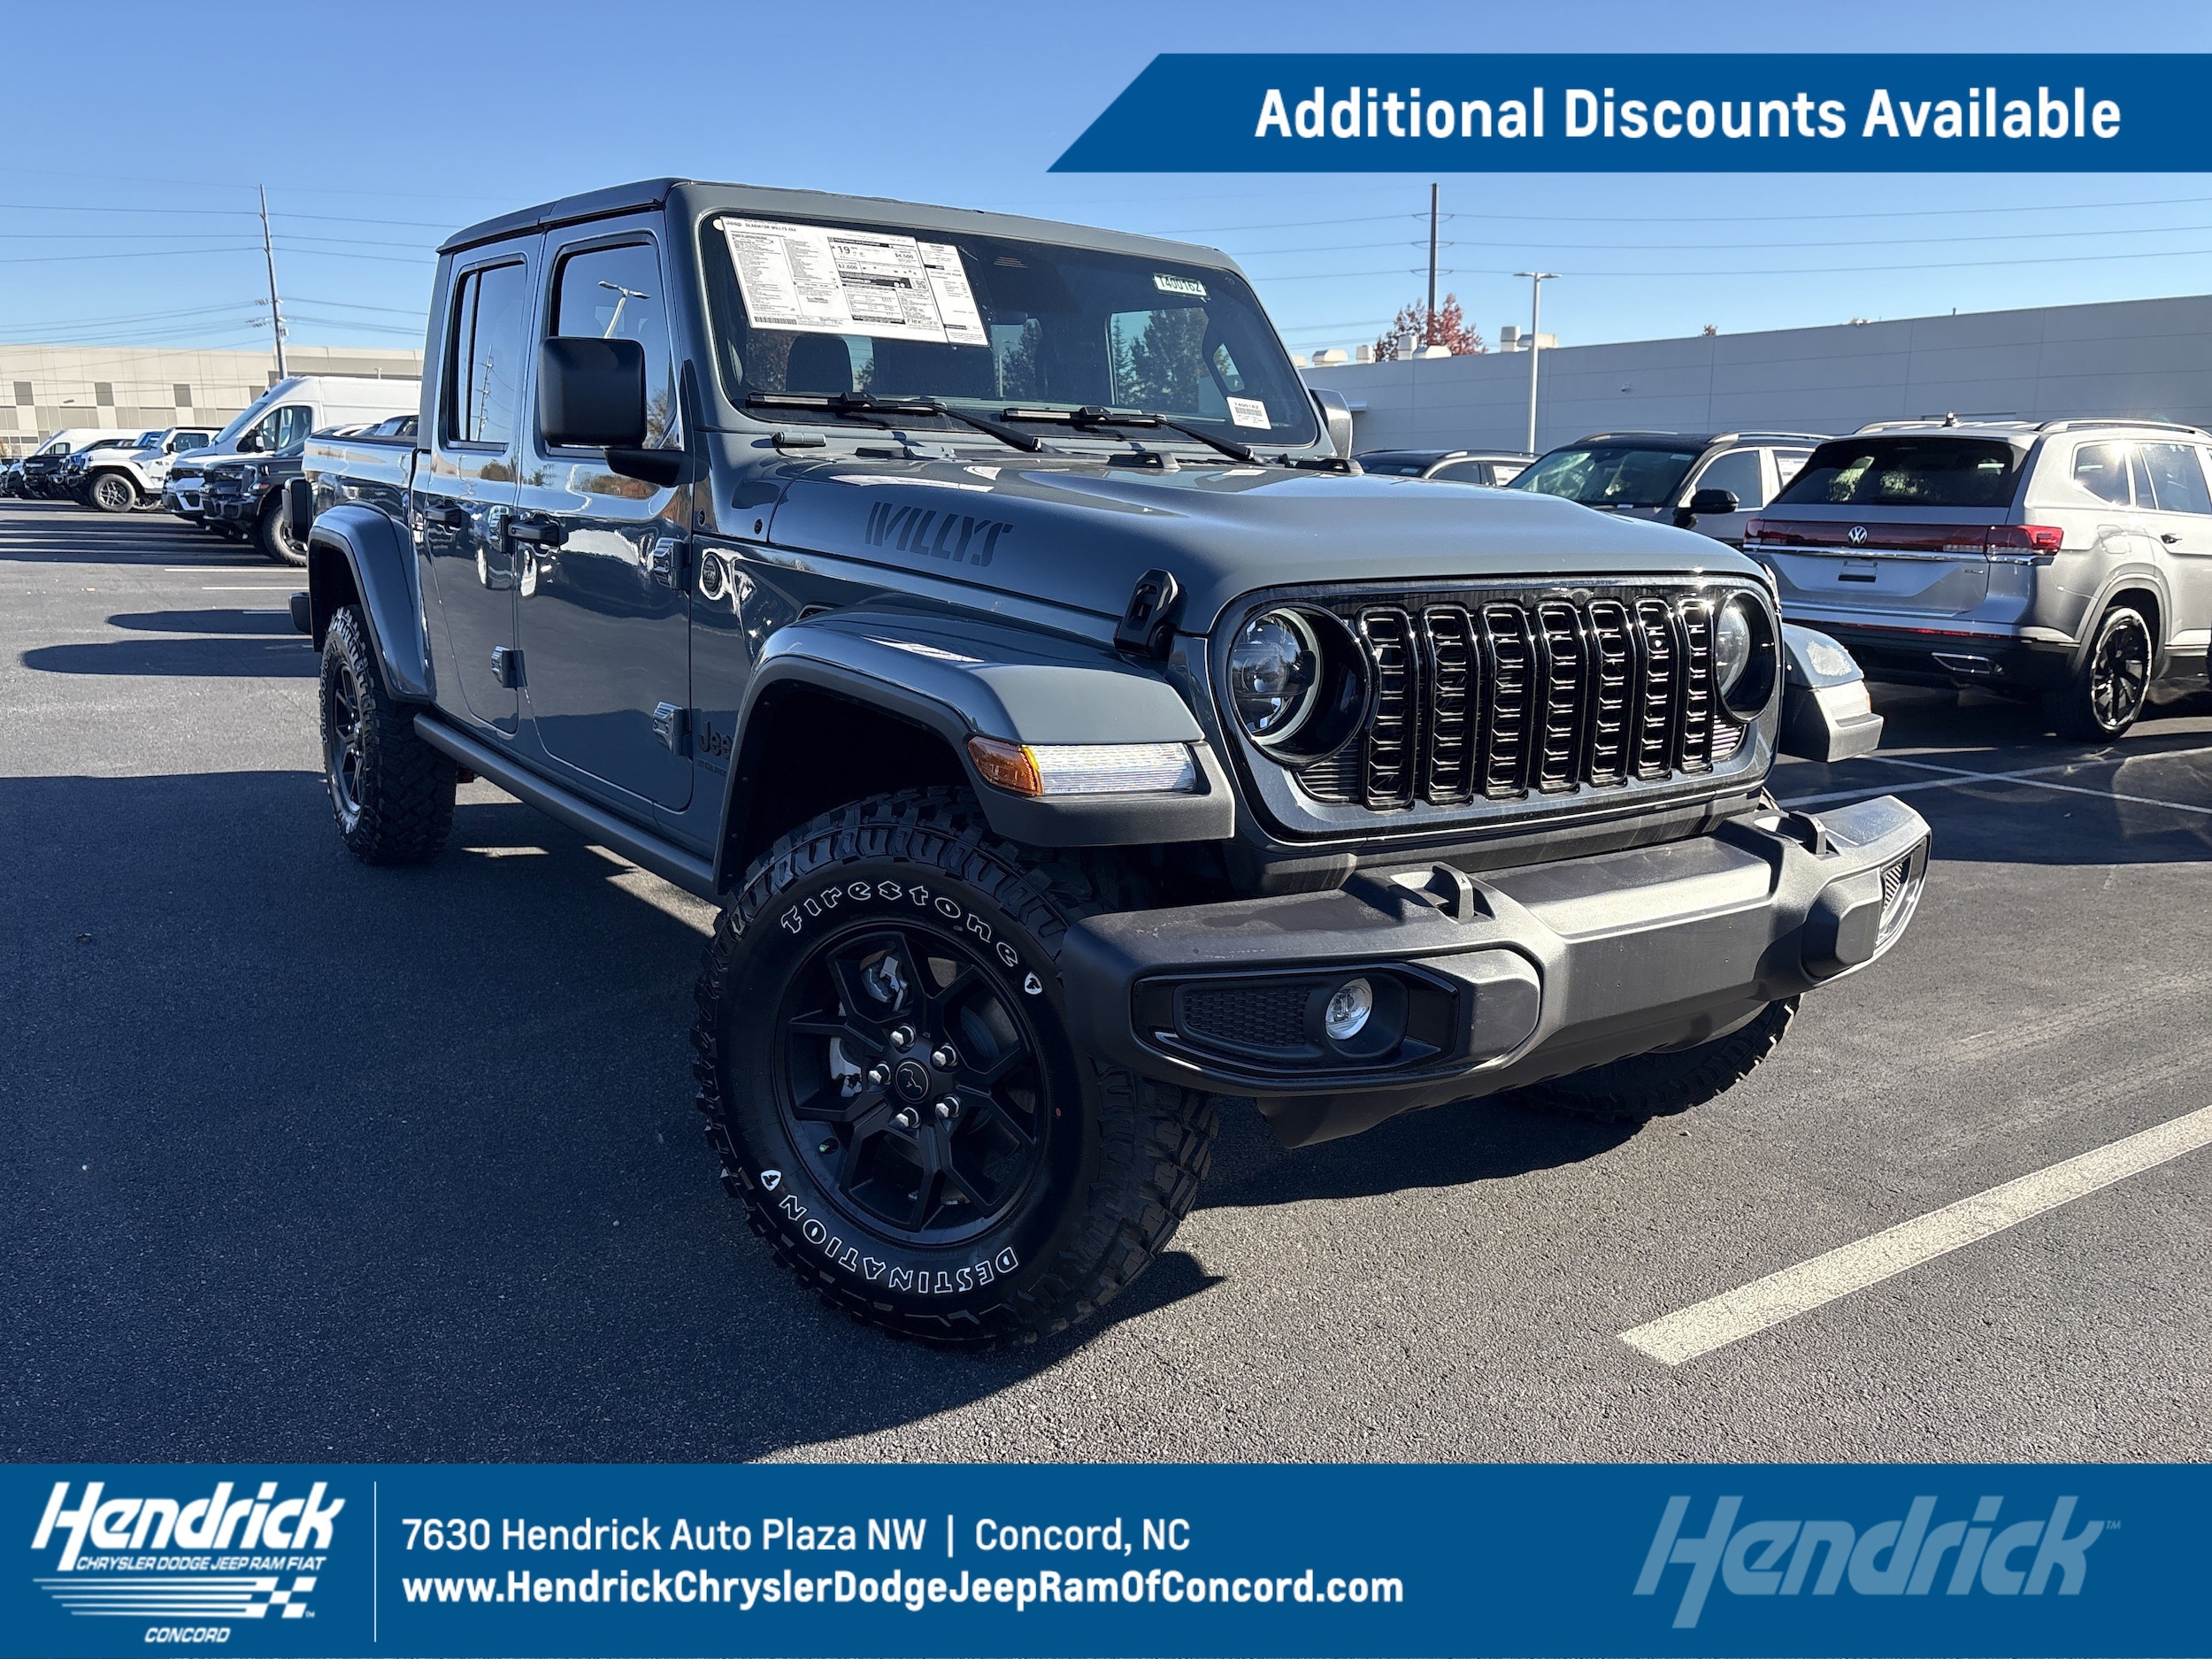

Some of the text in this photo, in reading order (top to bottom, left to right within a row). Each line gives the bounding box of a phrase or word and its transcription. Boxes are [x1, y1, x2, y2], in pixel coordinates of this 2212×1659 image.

[838, 245, 850, 255] 19
[864, 501, 1015, 567] WILLYS
[697, 721, 733, 762] Jee
[780, 880, 1019, 967] Firestone
[779, 1194, 1019, 1294] DESTINATION
